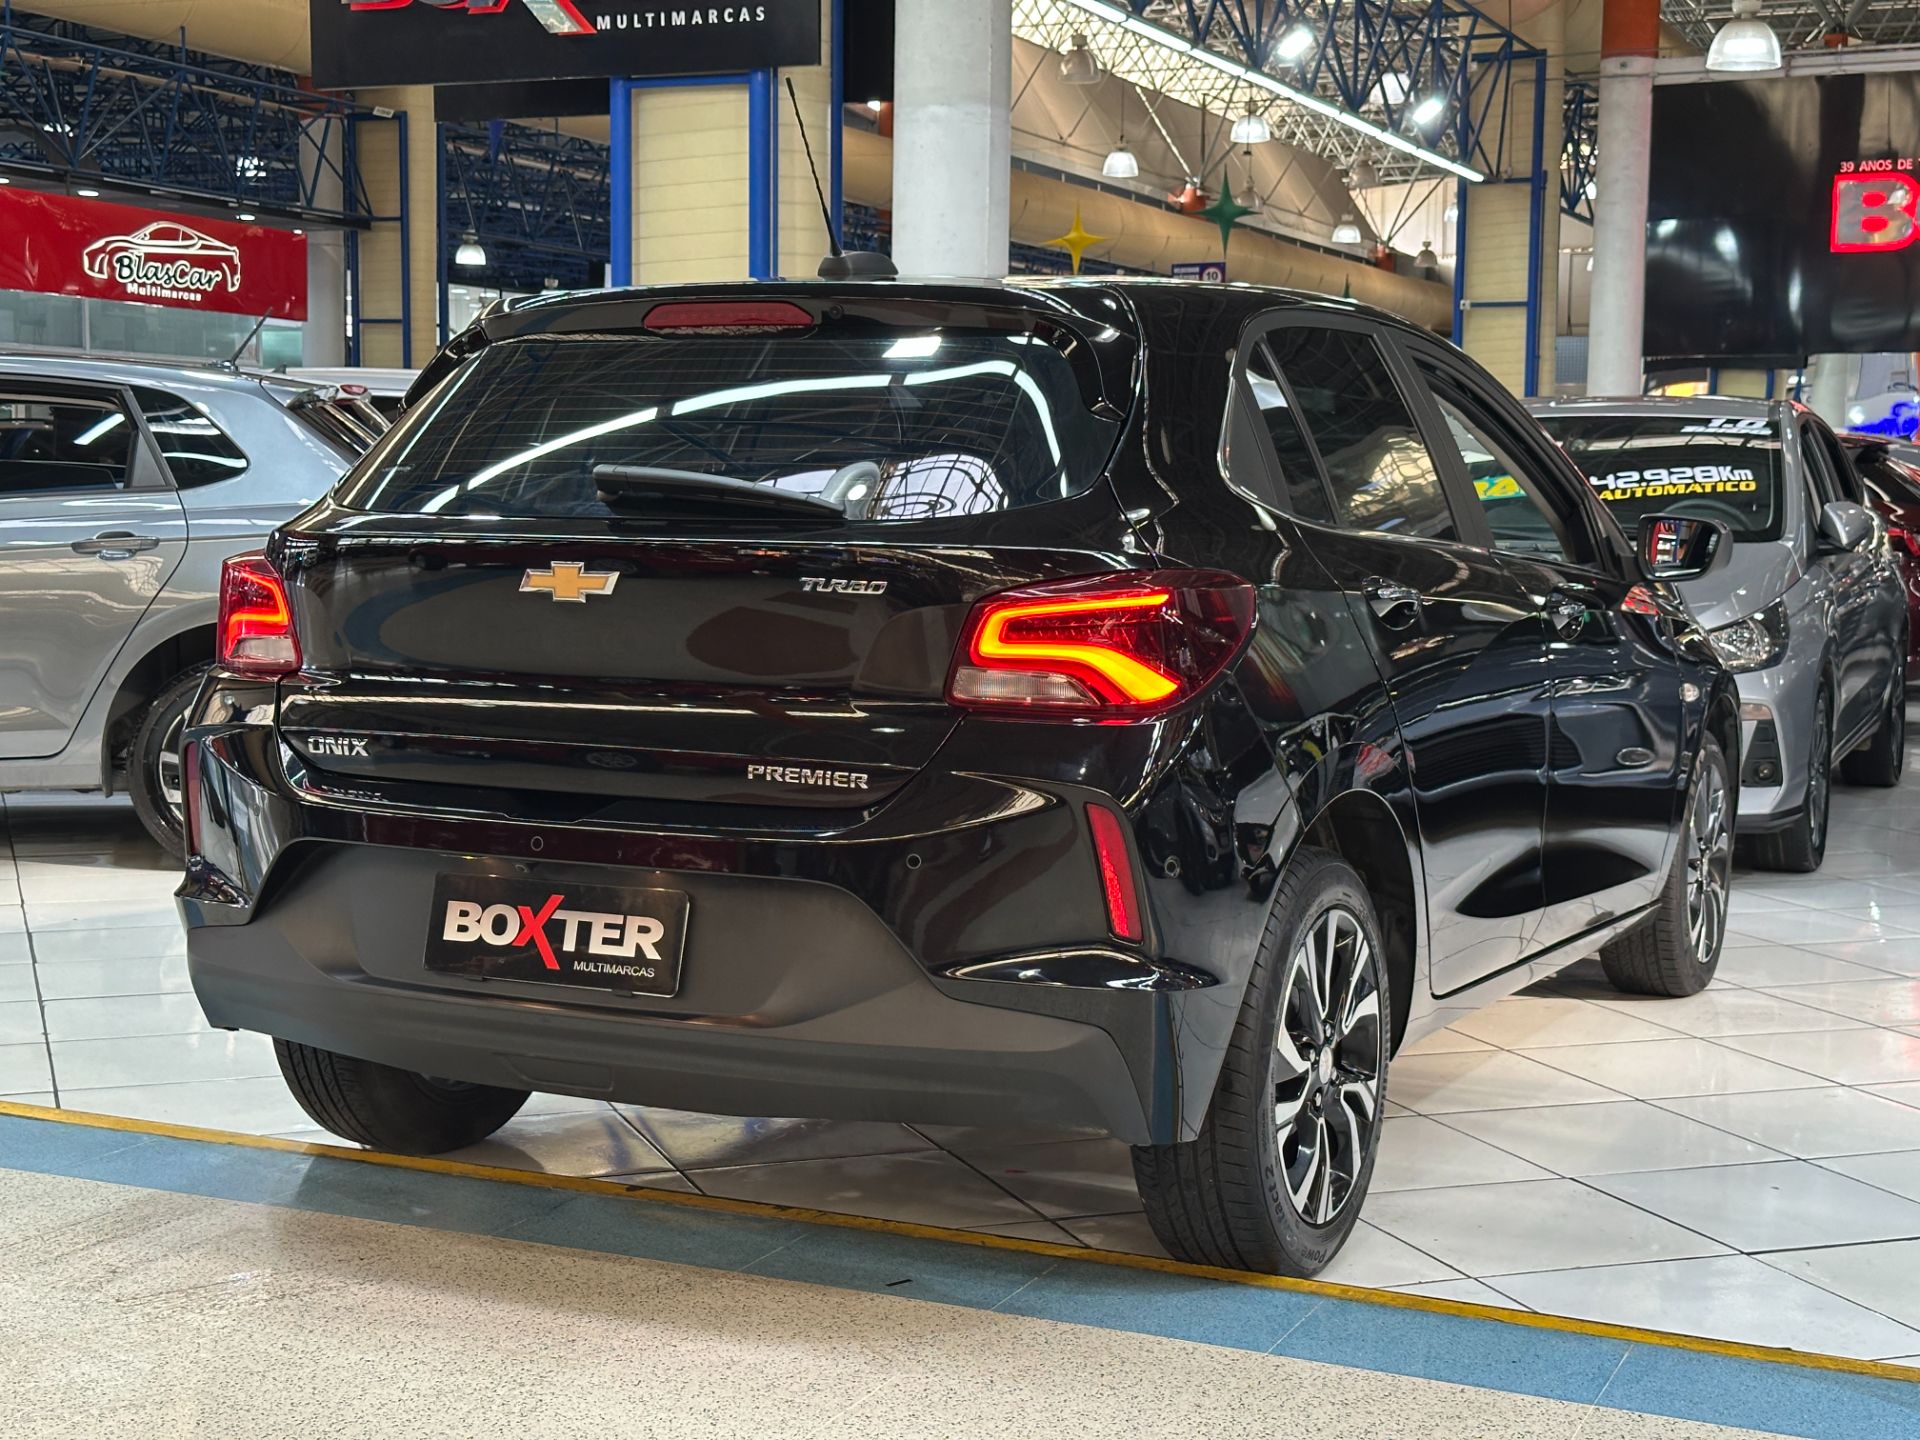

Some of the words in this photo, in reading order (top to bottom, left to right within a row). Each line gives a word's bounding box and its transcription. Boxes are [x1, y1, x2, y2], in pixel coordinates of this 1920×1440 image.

[596, 6, 765, 30] MULTIMARCAS
[1840, 161, 1854, 172] 39
[1859, 160, 1892, 172] ANOS
[1897, 159, 1913, 170] DE
[1830, 172, 1920, 252] B
[114, 251, 222, 291] BlasCar
[126, 283, 202, 301] Multimarcas
[1600, 480, 1757, 500] AUTOMATICO
[799, 577, 888, 595] TURBO
[308, 735, 368, 756] ONIX
[747, 764, 869, 789] PREMIER
[443, 893, 665, 971] BOXTER
[573, 960, 656, 978] MULTIMARCAS
